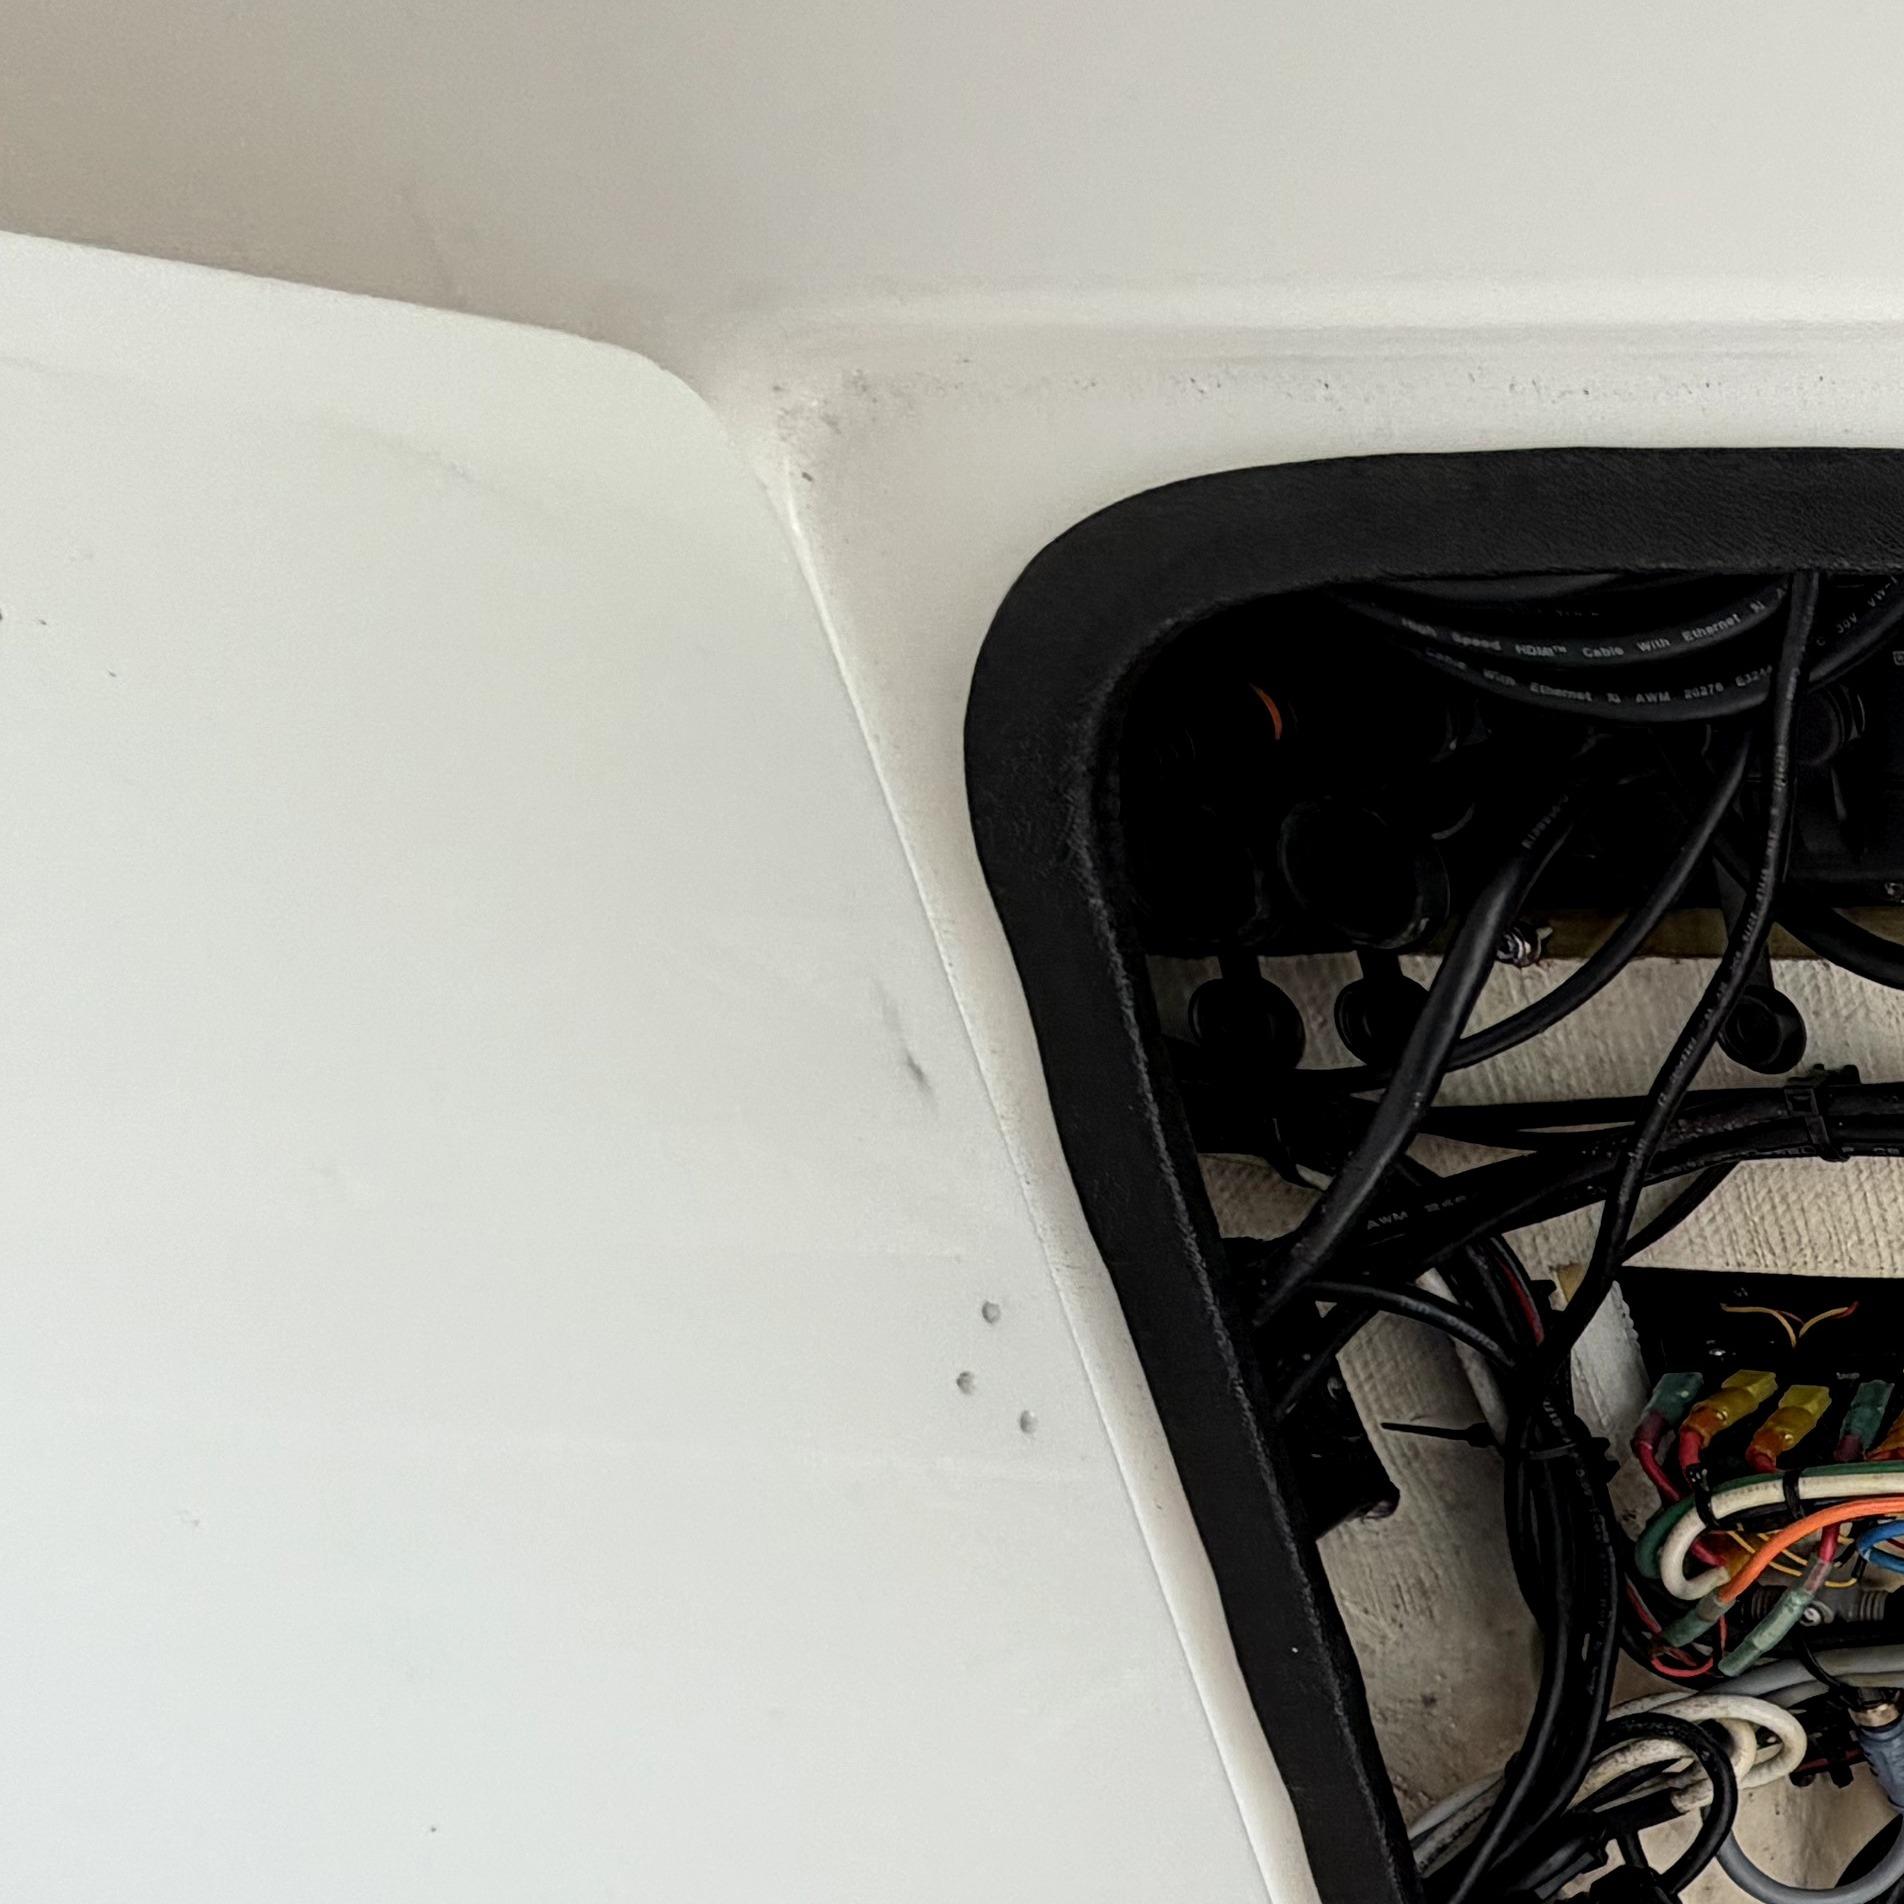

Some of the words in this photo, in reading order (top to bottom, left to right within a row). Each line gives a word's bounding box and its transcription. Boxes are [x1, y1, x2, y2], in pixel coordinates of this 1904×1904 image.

[1582, 645, 1625, 659] Cable
[1636, 636, 1672, 654] With
[1681, 613, 1742, 643] Ethernet
[1529, 681, 1593, 702] Ethernet
[1635, 690, 1672, 704] AWM
